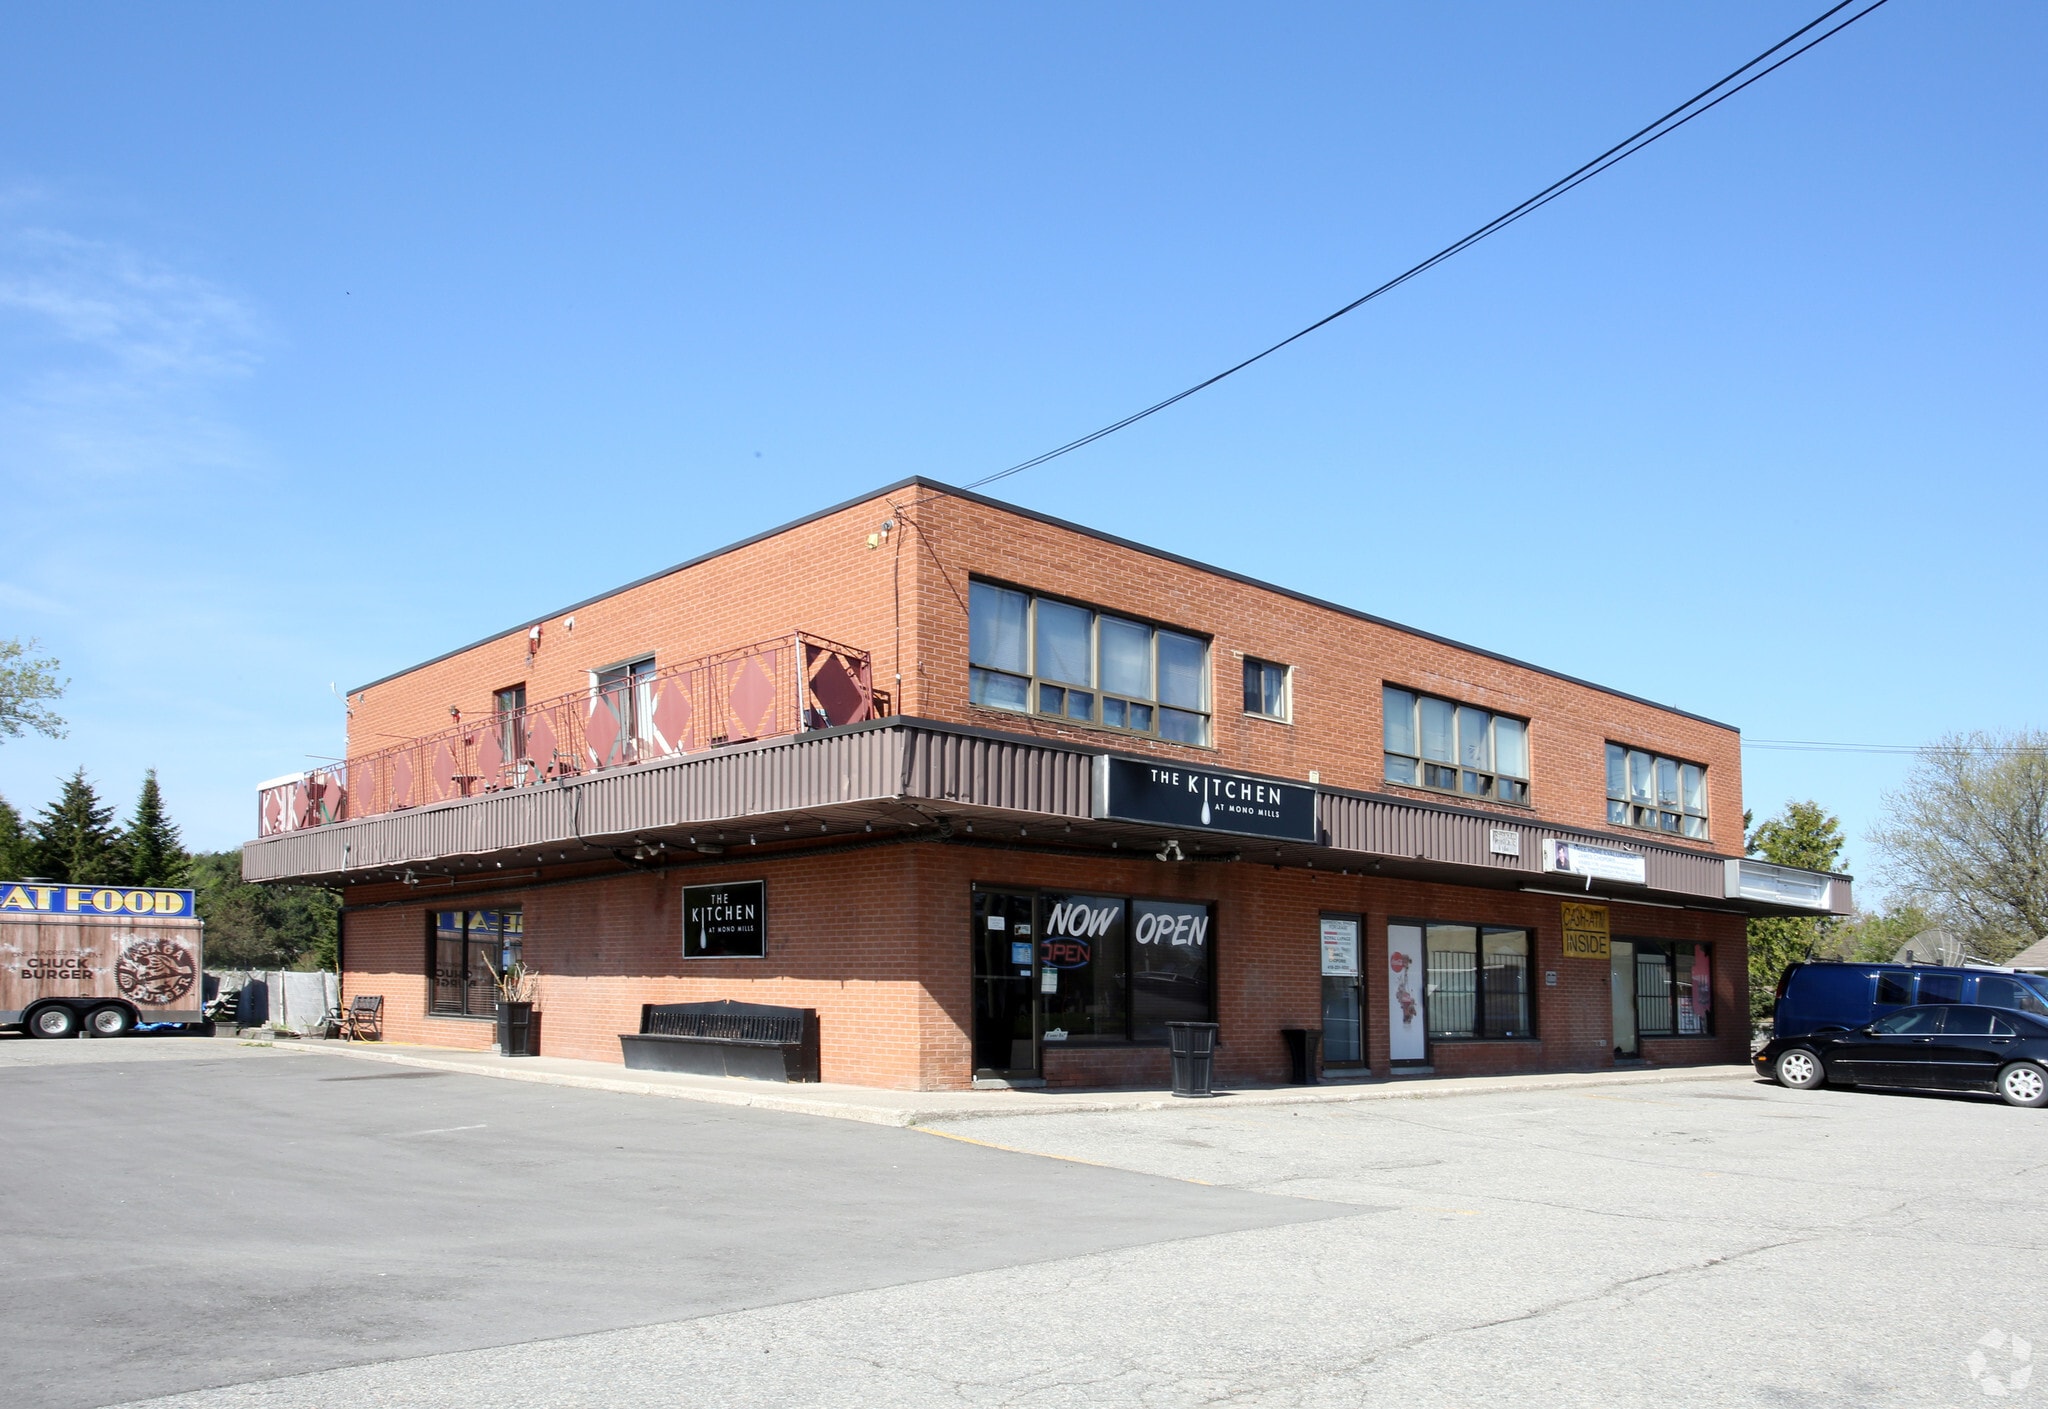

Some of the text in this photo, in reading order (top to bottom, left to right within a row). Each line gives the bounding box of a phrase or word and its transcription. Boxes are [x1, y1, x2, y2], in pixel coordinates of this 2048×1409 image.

[1151, 769, 1282, 807] THE KITCHEN
[1215, 803, 1280, 818] AT MONO MILLS
[66, 888, 183, 914] FOOD
[711, 893, 728, 905] THE
[692, 904, 755, 927] KITCHEN
[1047, 903, 1209, 946] NOW OPEN
[1041, 943, 1091, 962] OPEN
[1566, 933, 1607, 954] INSIDE
[27, 958, 89, 969] CHUCK
[21, 969, 94, 980] BURGER
